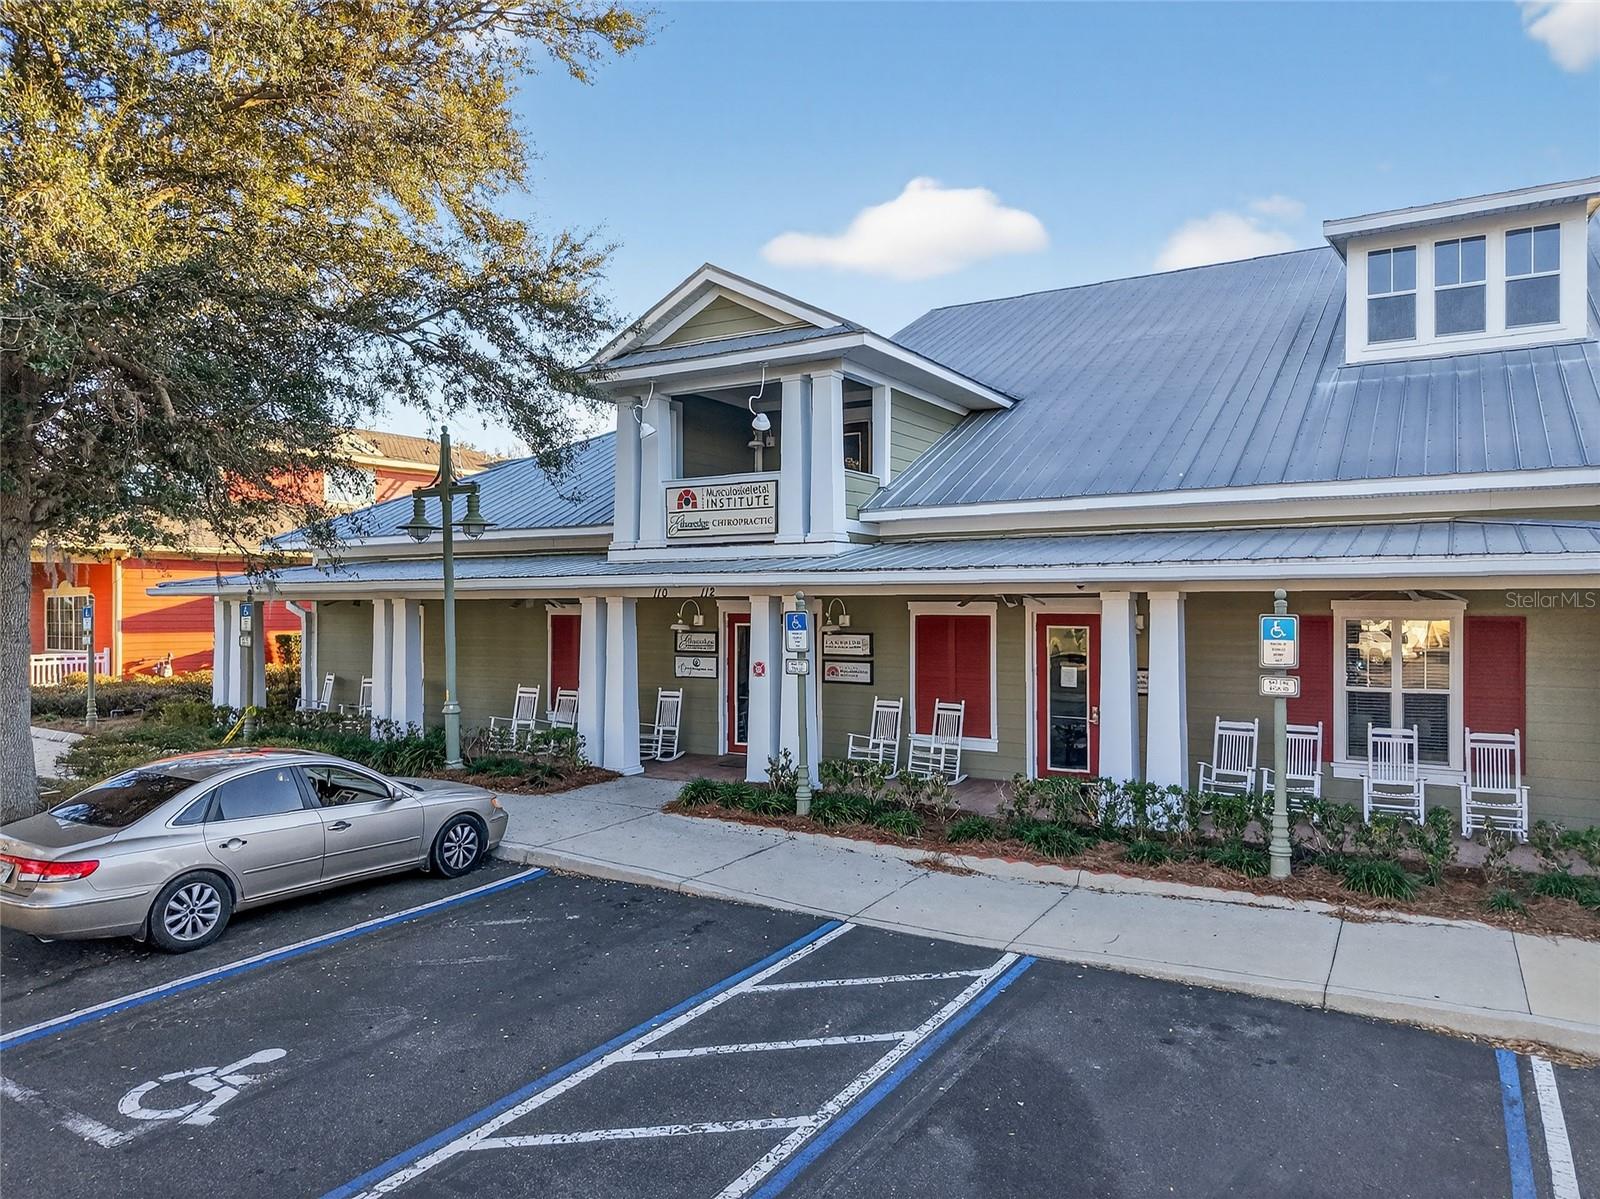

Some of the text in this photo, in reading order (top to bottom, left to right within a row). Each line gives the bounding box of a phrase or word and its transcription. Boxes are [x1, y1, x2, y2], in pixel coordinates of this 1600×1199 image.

[706, 483, 770, 498] Musculoskeletal
[706, 494, 770, 509] INSTITUTE
[711, 516, 774, 528] CHIROPRACTIC
[653, 587, 668, 598] 110
[700, 586, 716, 598] 112
